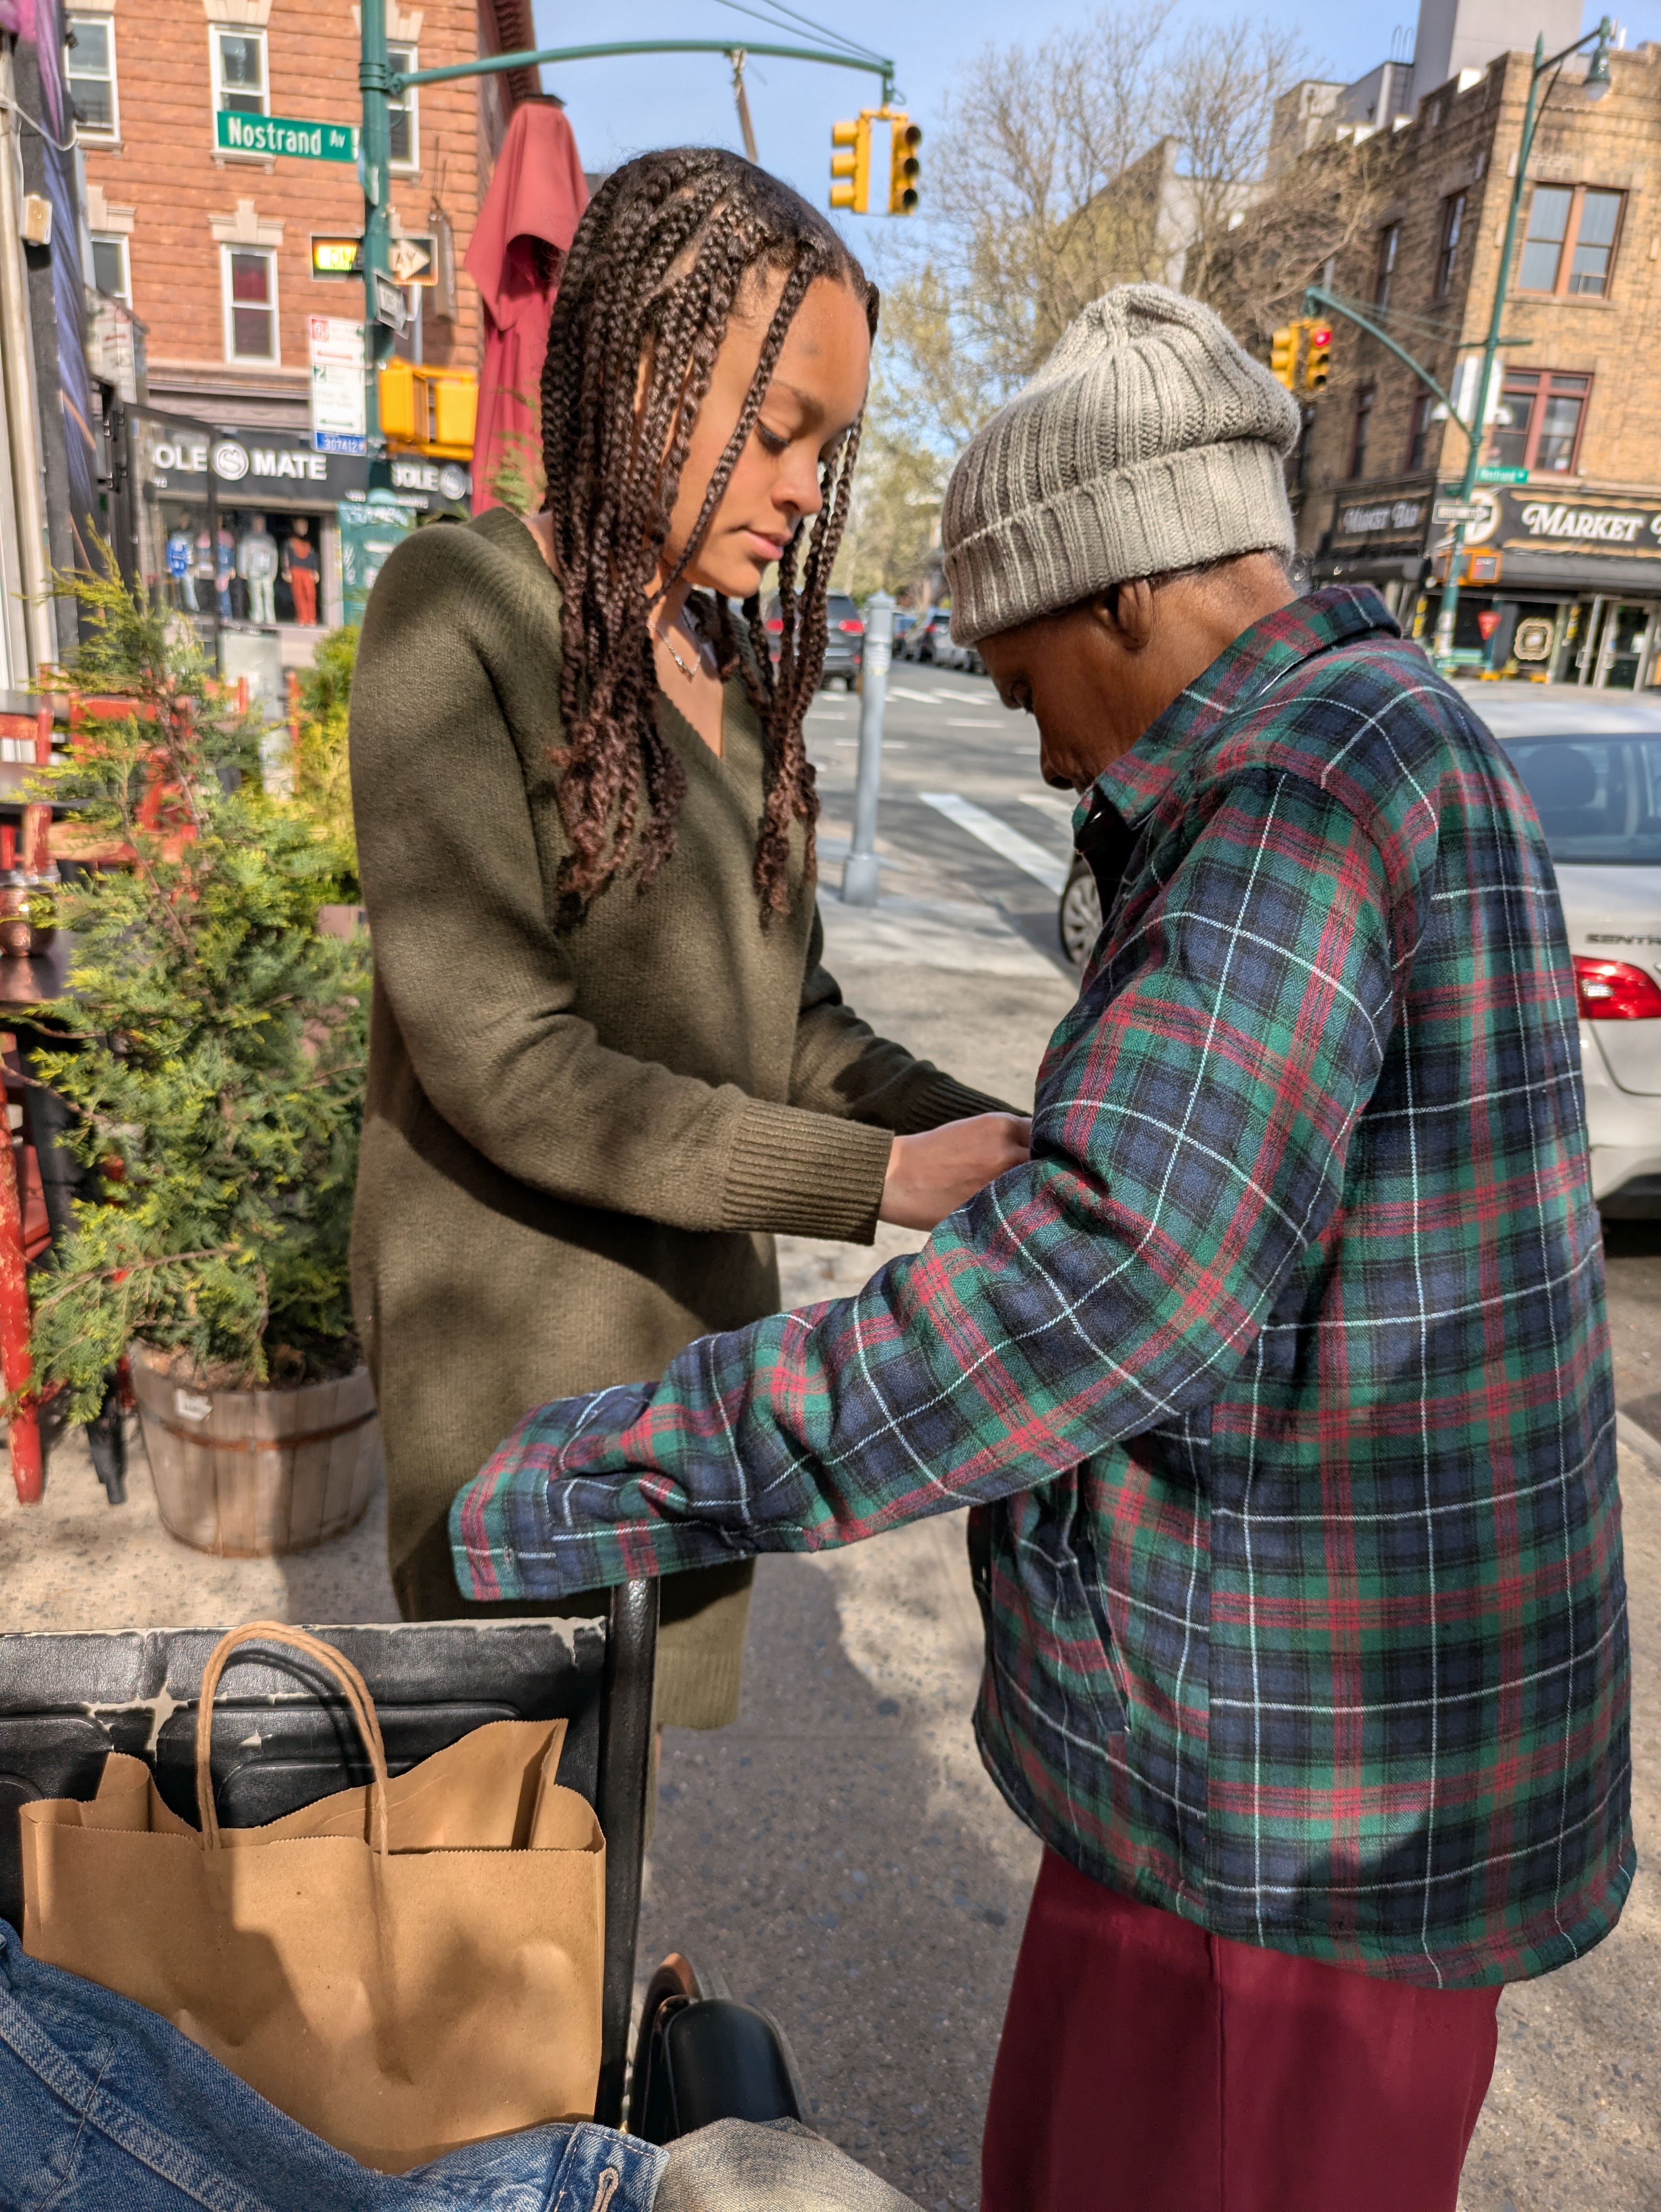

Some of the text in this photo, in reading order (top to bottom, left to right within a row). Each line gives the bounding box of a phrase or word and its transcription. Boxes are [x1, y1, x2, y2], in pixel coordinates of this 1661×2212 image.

[228, 116, 346, 155] Nostrand Av
[154, 442, 327, 481] OLE MATE
[1521, 503, 1646, 542] MARKET
